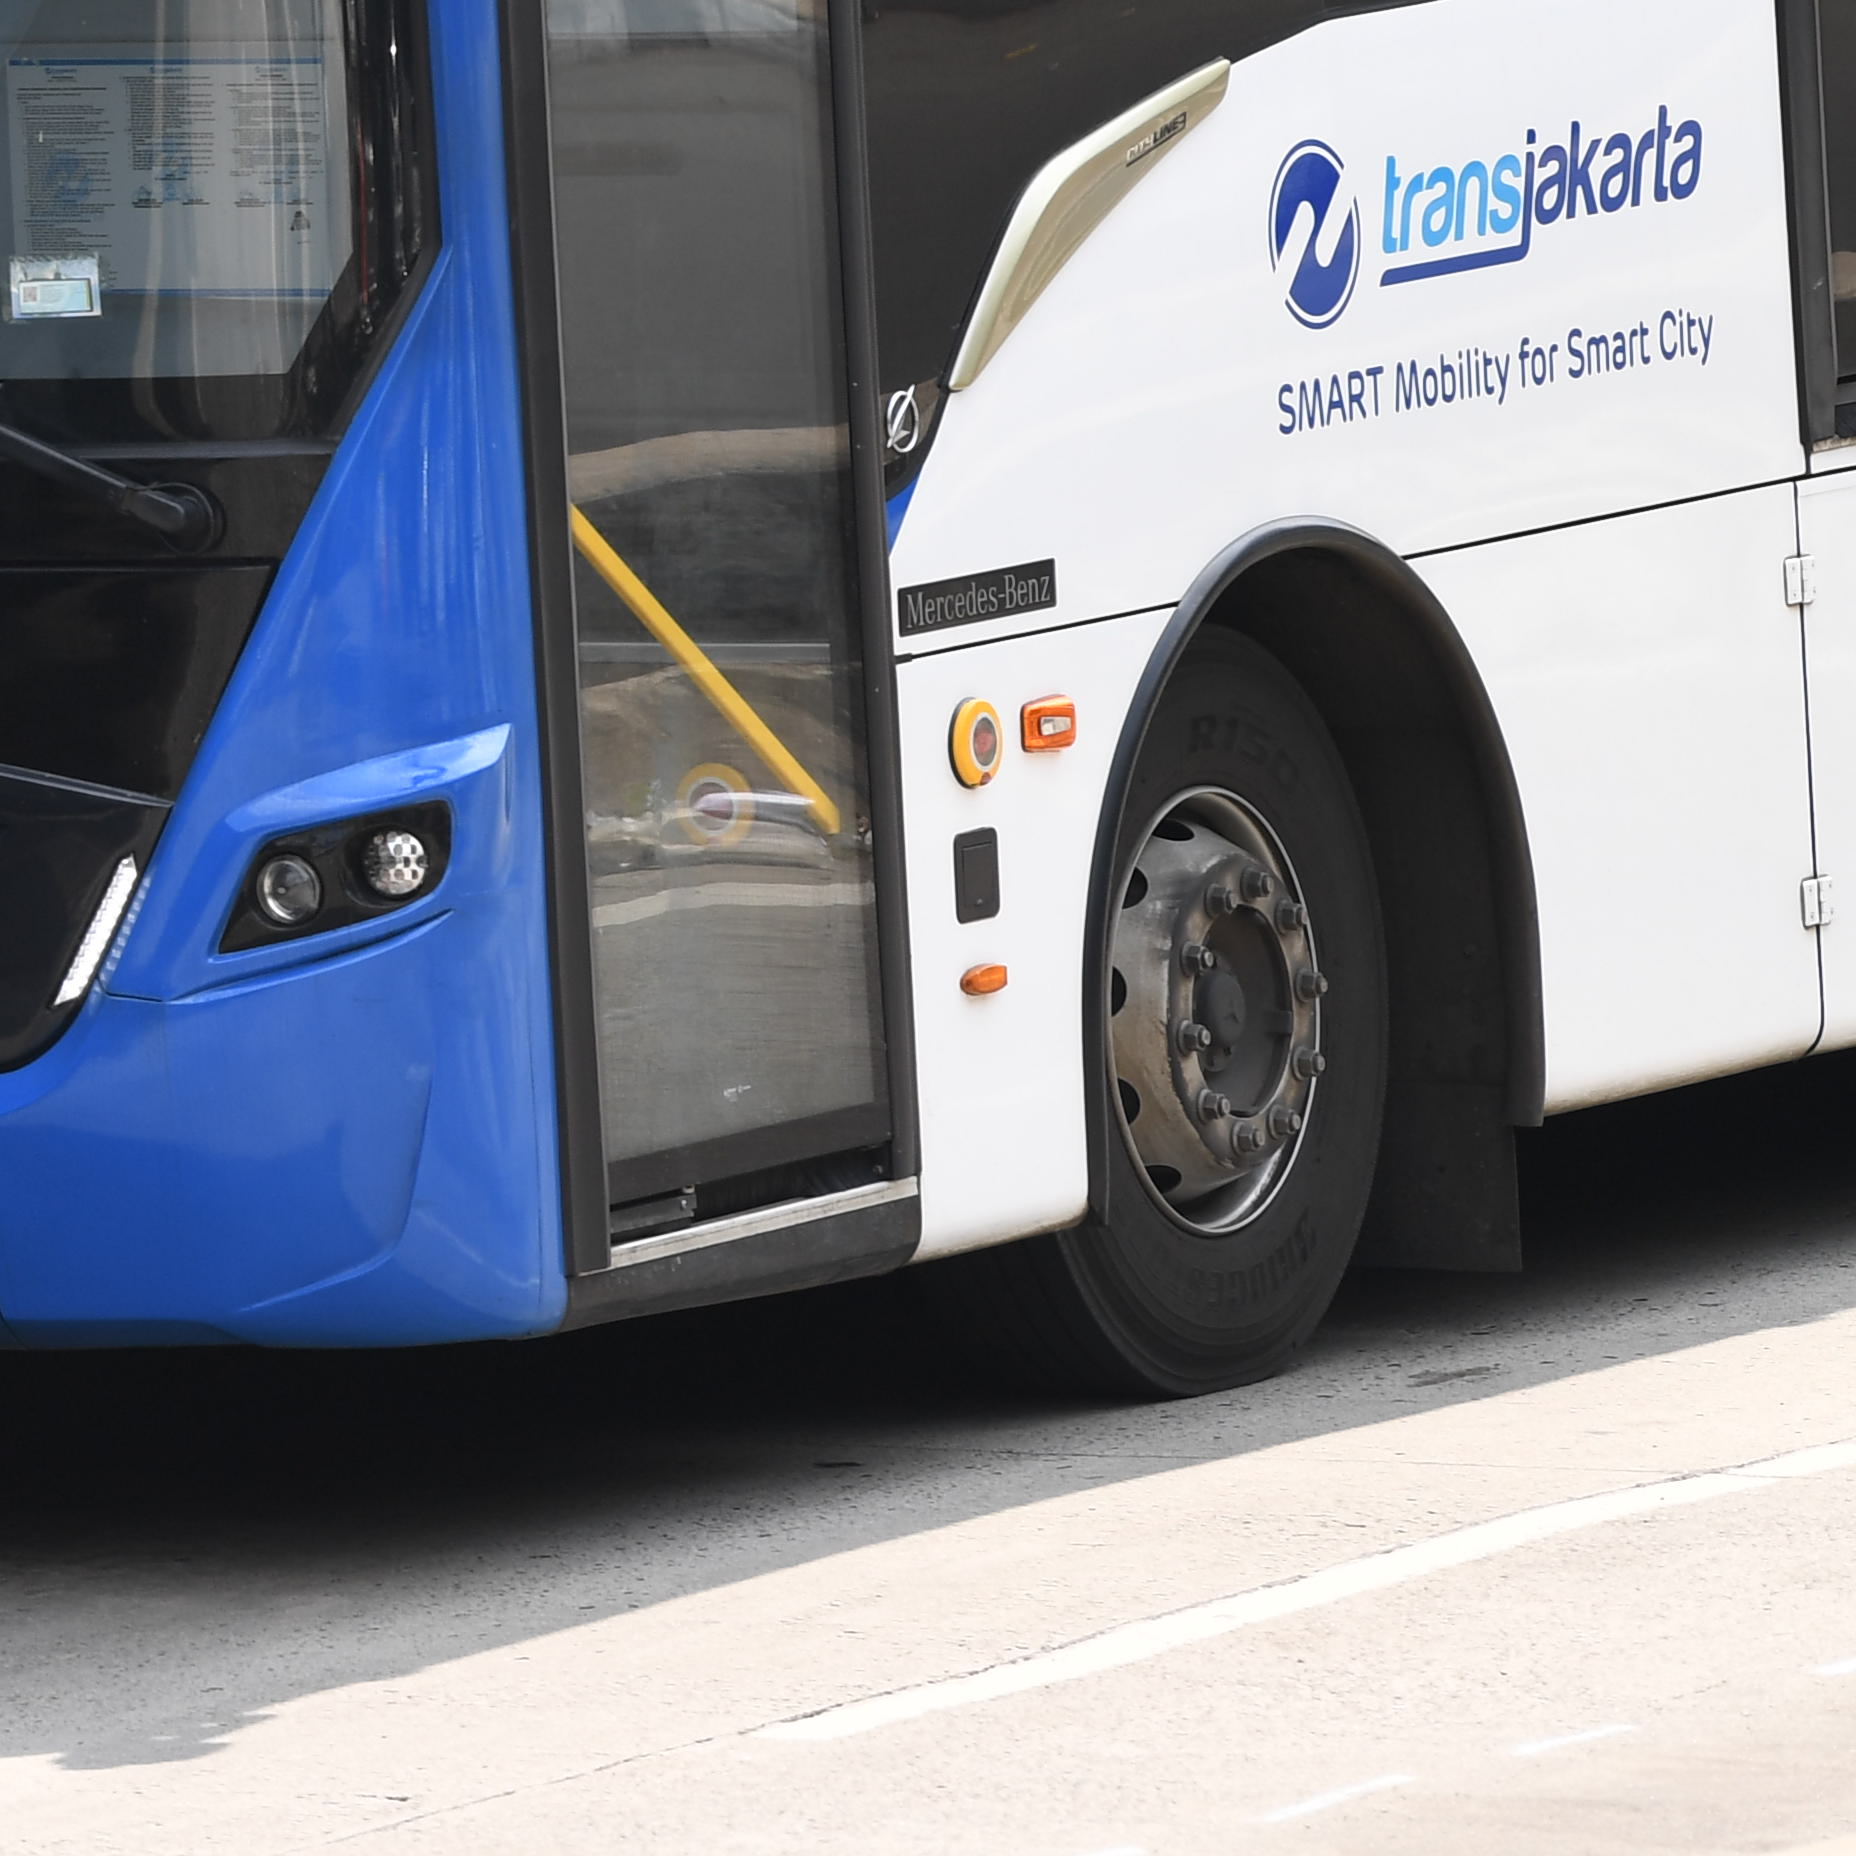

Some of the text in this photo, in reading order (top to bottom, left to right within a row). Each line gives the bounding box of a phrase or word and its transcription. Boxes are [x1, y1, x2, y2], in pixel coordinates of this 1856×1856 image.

[1380, 104, 1703, 286] transjakarta
[1278, 308, 1714, 435] SMART Mobility for Smart City
[906, 573, 1051, 629] Mercedes-Benz
